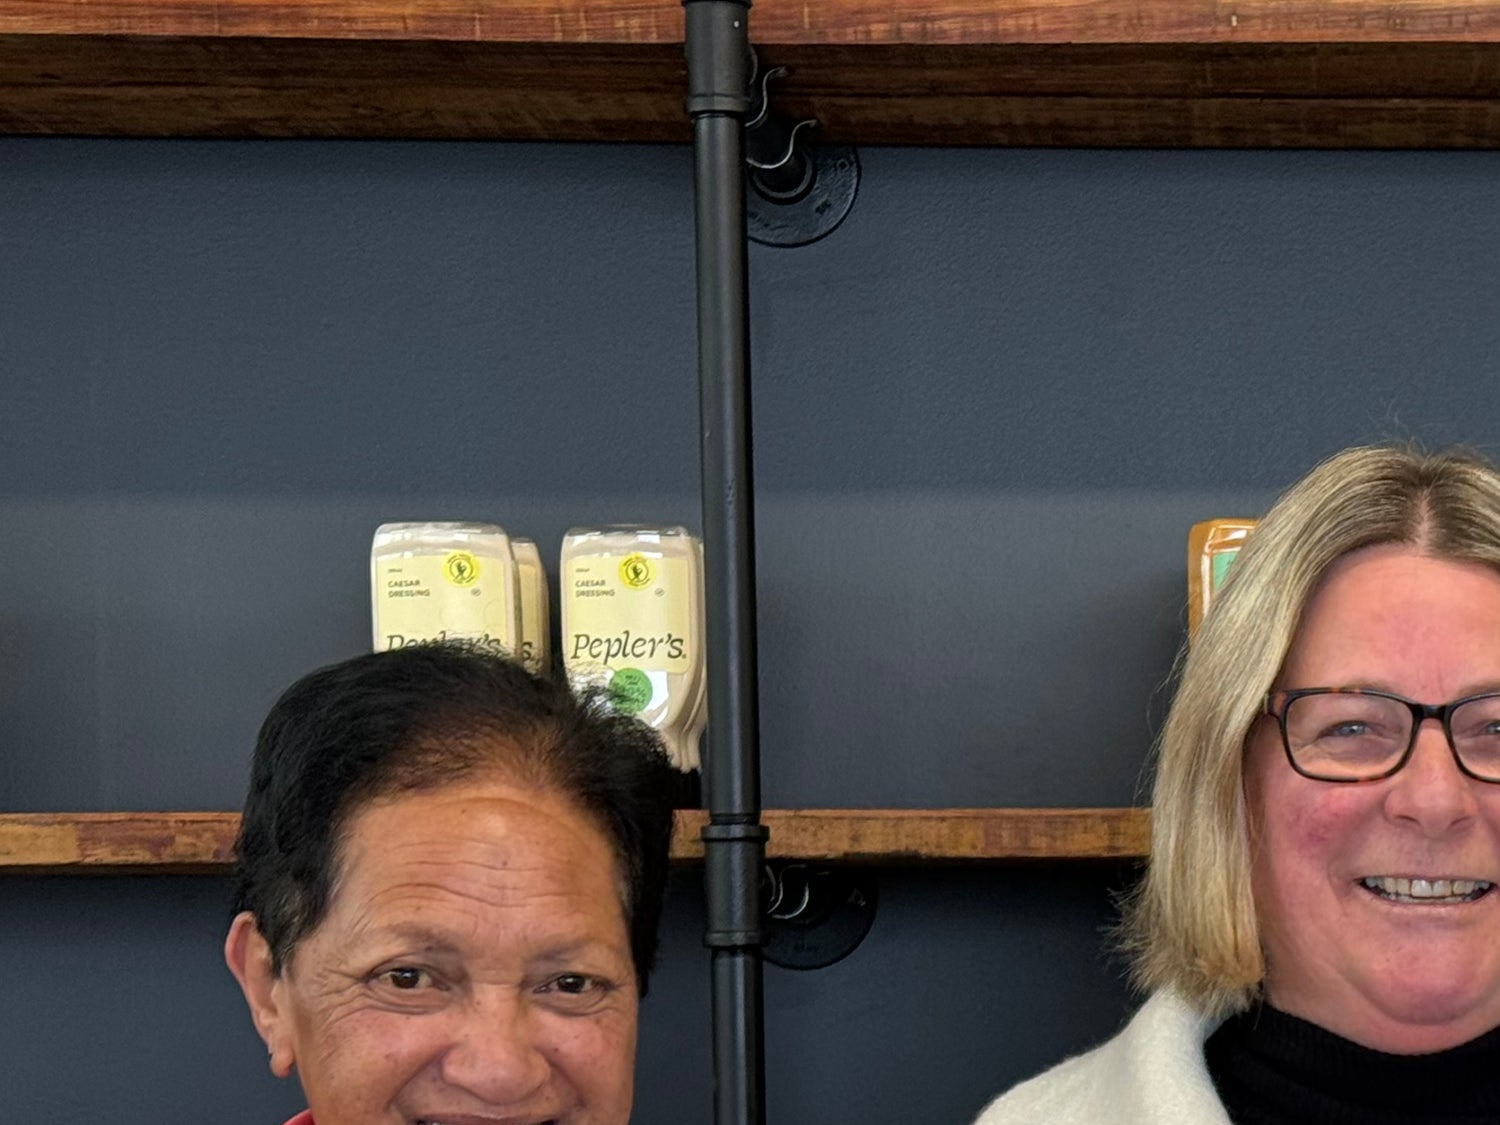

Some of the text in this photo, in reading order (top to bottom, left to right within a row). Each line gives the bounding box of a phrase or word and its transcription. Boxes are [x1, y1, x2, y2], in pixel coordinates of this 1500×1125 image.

[388, 580, 420, 588] CAESAR
[388, 589, 430, 597] DRESSING
[575, 589, 615, 597] DRESSING
